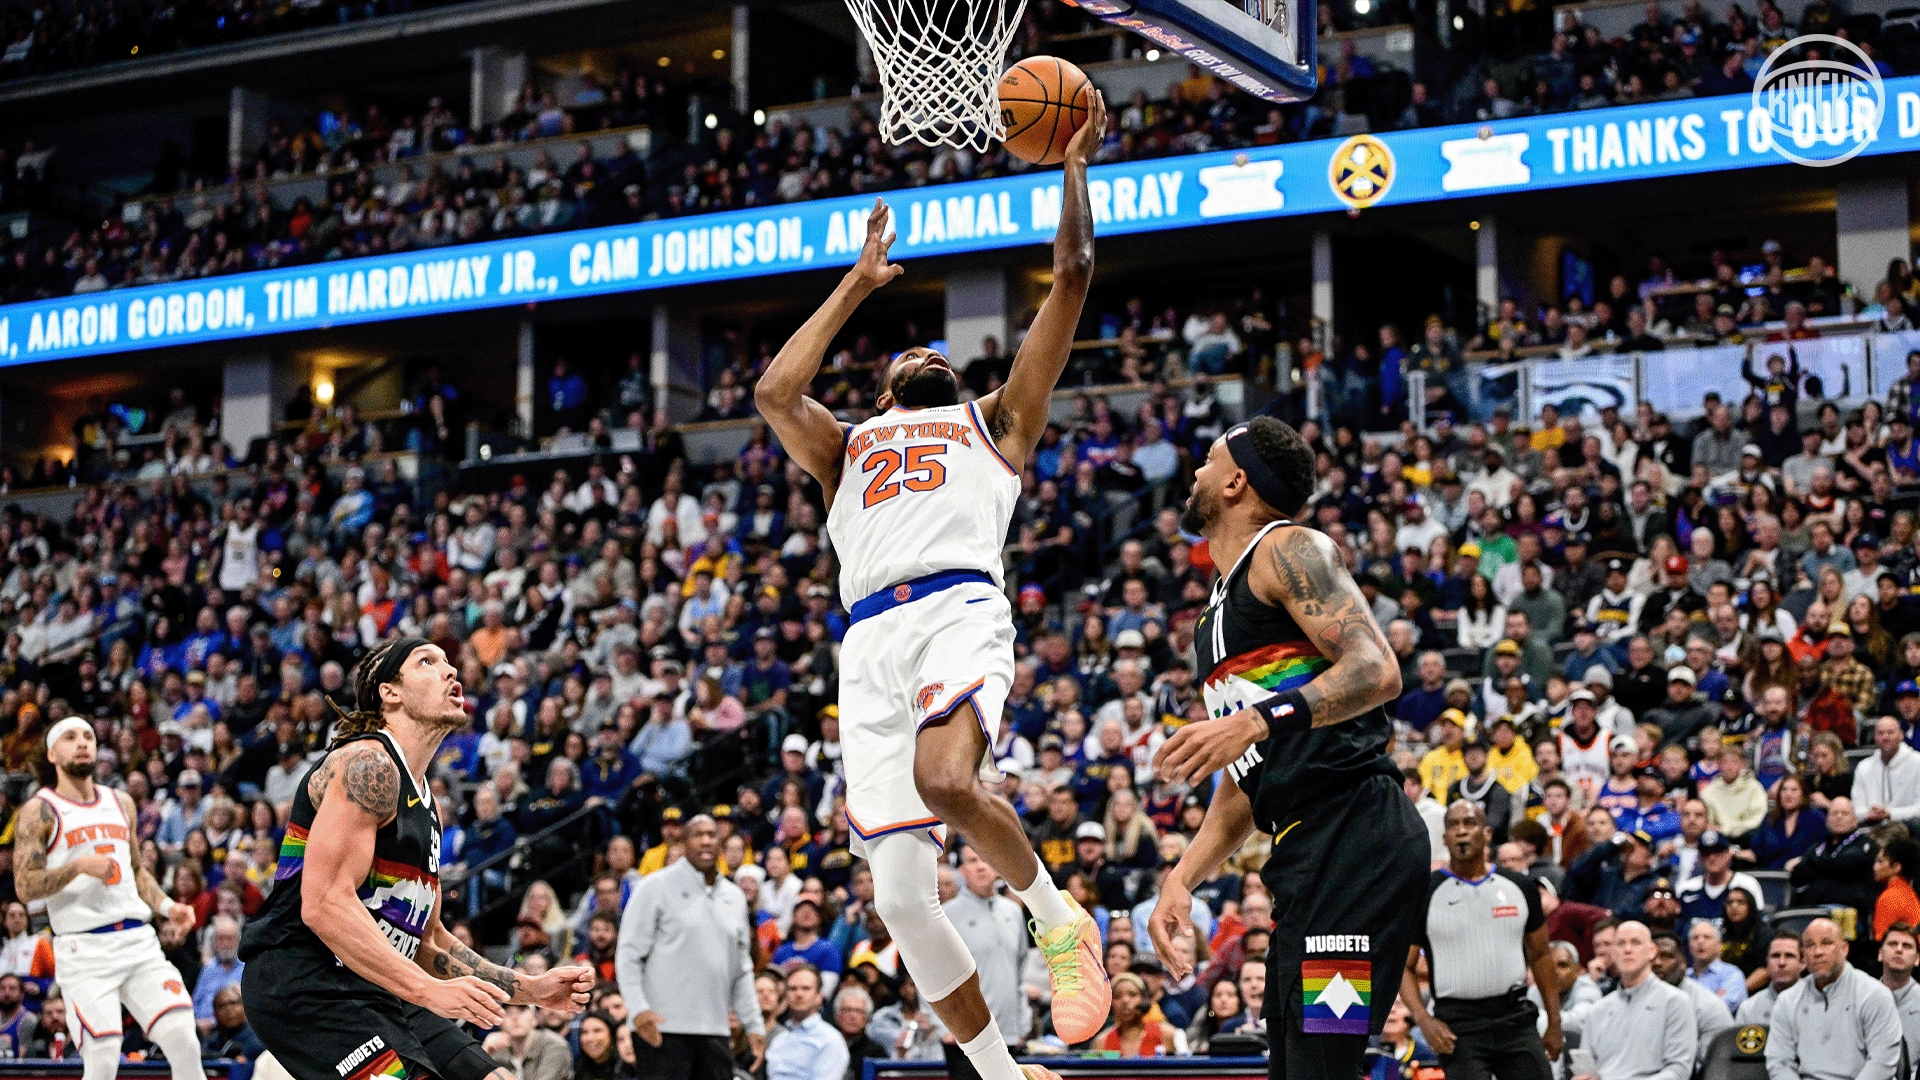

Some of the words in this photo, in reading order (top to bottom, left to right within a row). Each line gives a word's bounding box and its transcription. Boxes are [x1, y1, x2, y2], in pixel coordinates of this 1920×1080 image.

[1546, 113, 1706, 175] THANKS
[1720, 106, 1772, 156] TO
[1792, 96, 1878, 149] OUR
[27, 302, 118, 353] AARON
[128, 285, 255, 340] GORDON,
[264, 275, 318, 323] TIM
[327, 254, 491, 316] HARDAWAY
[499, 249, 559, 294] JR.,
[569, 235, 640, 286] CAM
[648, 216, 815, 278] JOHNSON,
[906, 190, 1019, 246] JAMAL
[1031, 170, 1184, 231] MRRAY
[847, 424, 900, 467] NEW
[901, 421, 972, 449] YORK
[861, 443, 947, 510] 25
[65, 824, 97, 849] NEW
[1304, 934, 1370, 954] NUGGETS
[335, 1034, 386, 1078] NUGGETS
